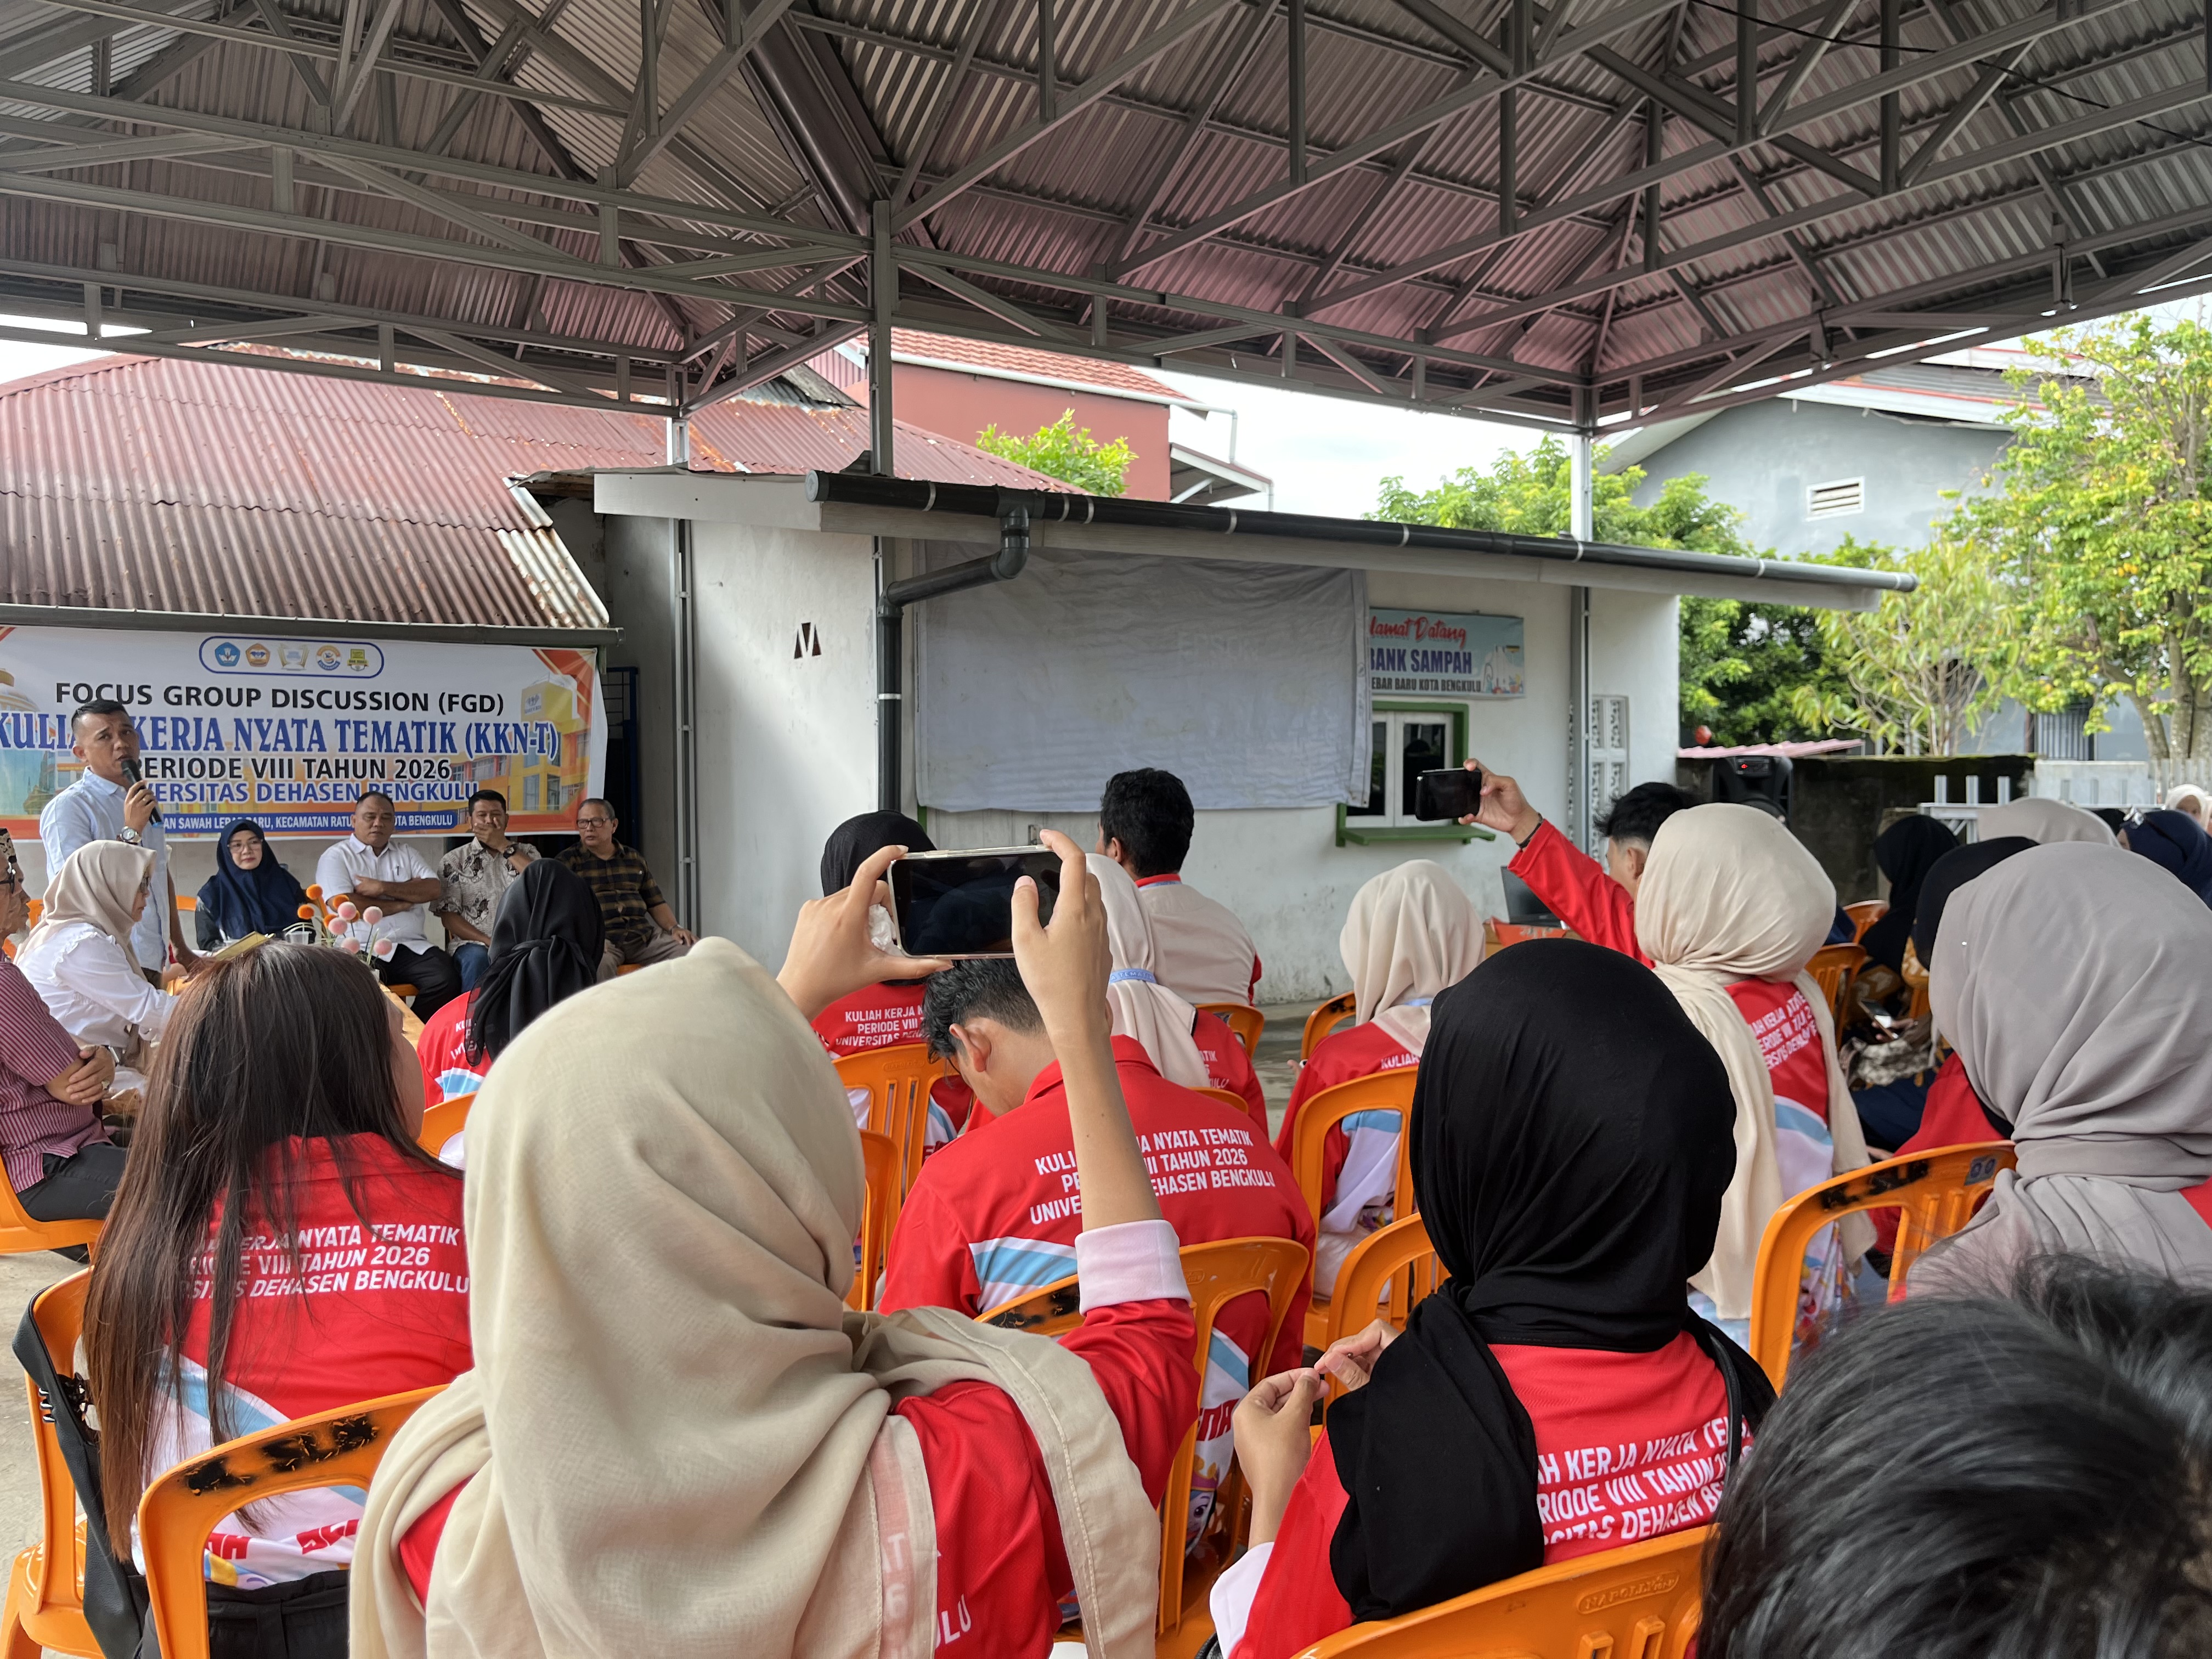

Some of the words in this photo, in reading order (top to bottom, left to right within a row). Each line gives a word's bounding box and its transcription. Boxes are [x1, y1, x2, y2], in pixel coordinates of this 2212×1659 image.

[1370, 616, 1415, 637] lamat
[1414, 616, 1467, 650] Datang
[1410, 649, 1472, 674] SAMPAH
[1372, 677, 1392, 690] EBAR
[1395, 678, 1417, 690] BARU
[1419, 679, 1439, 691] KOTA
[1441, 679, 1481, 692] BENGKULU
[56, 682, 153, 704] FOCUS
[164, 685, 261, 707] GROUP
[272, 688, 428, 712] DISCUSSION
[439, 692, 504, 716] (FGD)
[0, 713, 74, 749] KULI
[132, 716, 225, 751] KERJA
[234, 718, 327, 752] NYATA
[335, 718, 458, 753] TEMATIK
[465, 721, 558, 759] (KKN-T)
[251, 758, 294, 779] VIII
[302, 758, 385, 779] TAHUN
[394, 758, 451, 779] 2026
[148, 783, 249, 802] ERSITAS
[257, 783, 360, 802] DEHASEN
[178, 817, 212, 829] SAWAH
[215, 817, 242, 829] LEB
[275, 816, 329, 828] KECAMATAN
[331, 816, 352, 827] RATU
[409, 815, 453, 826] BENGKULU
[845, 1009, 882, 1022] KULIAH
[884, 1006, 916, 1019] KERJA
[857, 1020, 900, 1034] PERIODE
[901, 1018, 918, 1030] VIII
[836, 1032, 900, 1047] UNIVERSITAS
[1034, 1150, 1076, 1176] KULI
[1153, 1129, 1200, 1151] NYATA
[1199, 1127, 1254, 1147] TEMATIK
[1160, 1149, 1211, 1172] TAHUN
[1212, 1147, 1248, 1167] 2026
[1150, 1170, 1208, 1197] EHASEN
[1211, 1168, 1276, 1189] BENGKULU
[240, 1233, 289, 1251] ERJA
[297, 1224, 361, 1249] NYATA
[371, 1223, 461, 1246] TEMATIK
[258, 1255, 291, 1275] VIII
[300, 1248, 368, 1274] TAHUN
[370, 1245, 431, 1267] 2026
[250, 1271, 349, 1299] DEHASEN
[354, 1269, 470, 1294] BENGKULU
[1565, 1442, 1638, 1482] KERJA
[1639, 1429, 1698, 1465] NYATA
[1537, 1486, 1606, 1525] RIODE
[1605, 1474, 1648, 1506] VIII
[1642, 1456, 1715, 1497] TAHUN
[1621, 1491, 1703, 1539] DEHASEN
